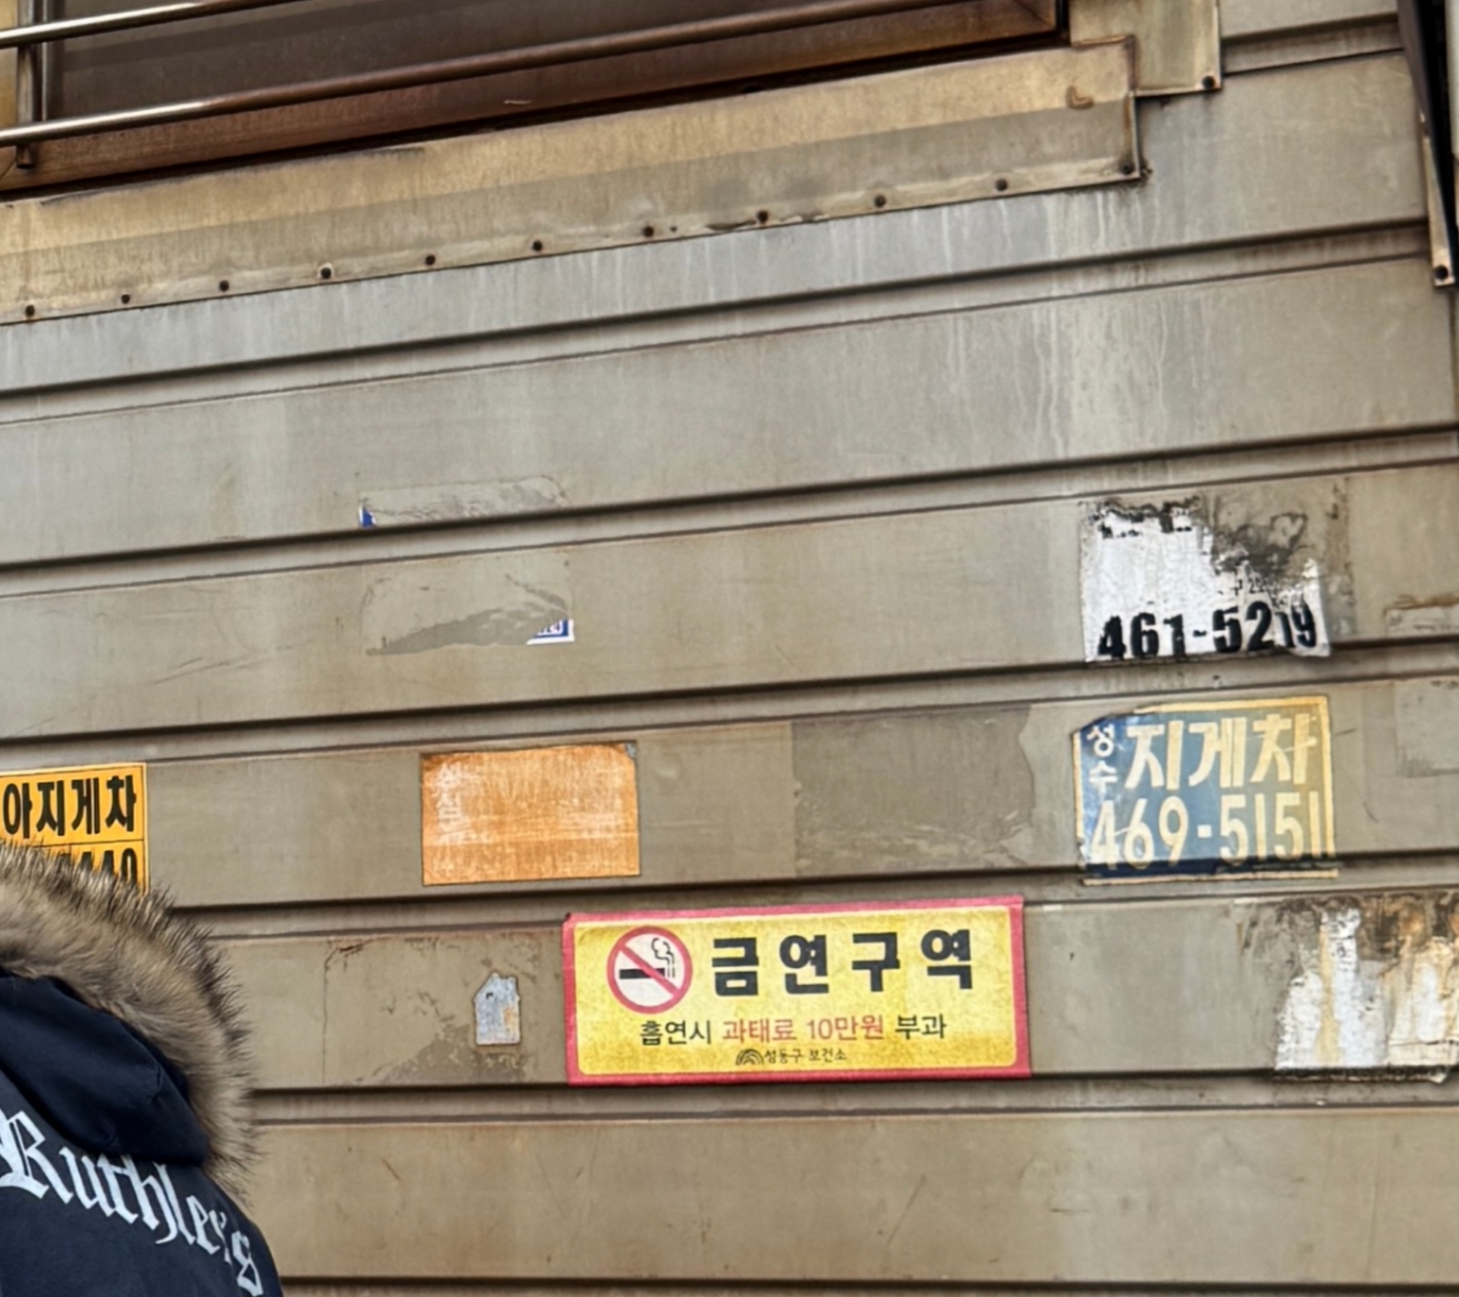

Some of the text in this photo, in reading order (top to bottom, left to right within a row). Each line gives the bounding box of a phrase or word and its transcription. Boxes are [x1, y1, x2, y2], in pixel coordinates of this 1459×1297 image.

[1125, 714, 1317, 791] 지게차
[711, 929, 973, 997] 금연구역
[640, 1013, 947, 1045] 흡연시 과태료 10만원 부과
[764, 1048, 847, 1064] 성동구 보건소
